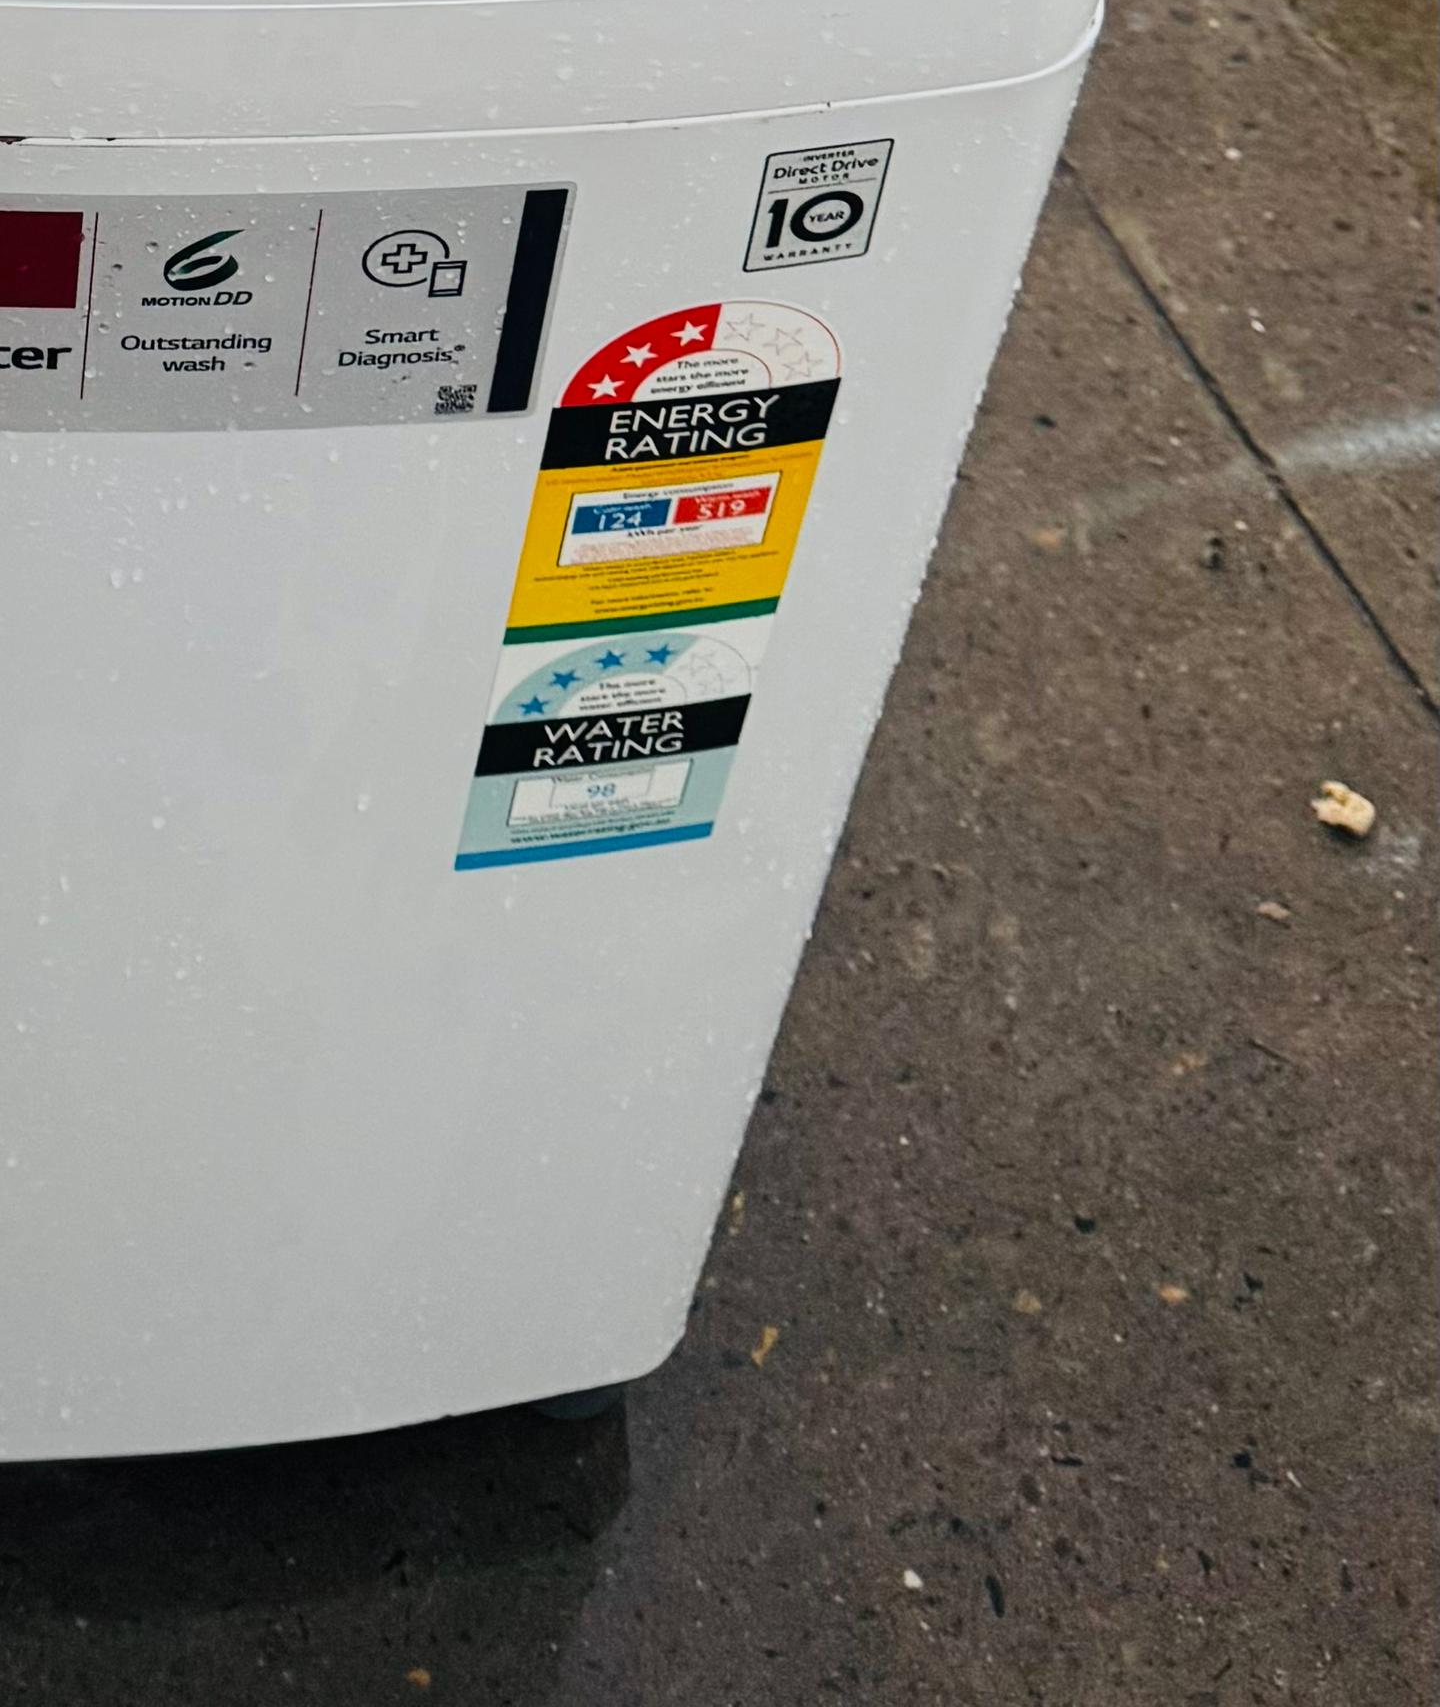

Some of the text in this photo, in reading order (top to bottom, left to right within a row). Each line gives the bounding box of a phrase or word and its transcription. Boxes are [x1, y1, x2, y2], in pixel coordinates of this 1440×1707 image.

[803, 149, 855, 162] INVERTER
[773, 157, 879, 179] Direct Drive
[799, 173, 850, 184] MOTOR
[765, 191, 864, 248] 10
[809, 210, 845, 223] YEAR
[763, 243, 852, 261] WARRANTY
[120, 333, 273, 353] Outstanding
[364, 328, 440, 345] Smart
[162, 356, 226, 372] wash
[609, 394, 780, 434] ENERGY
[604, 423, 768, 461] RATING
[696, 499, 747, 520] 519
[598, 511, 642, 531] 124
[544, 710, 684, 744] WATER
[532, 732, 685, 767] RATING
[587, 782, 616, 798] 98
